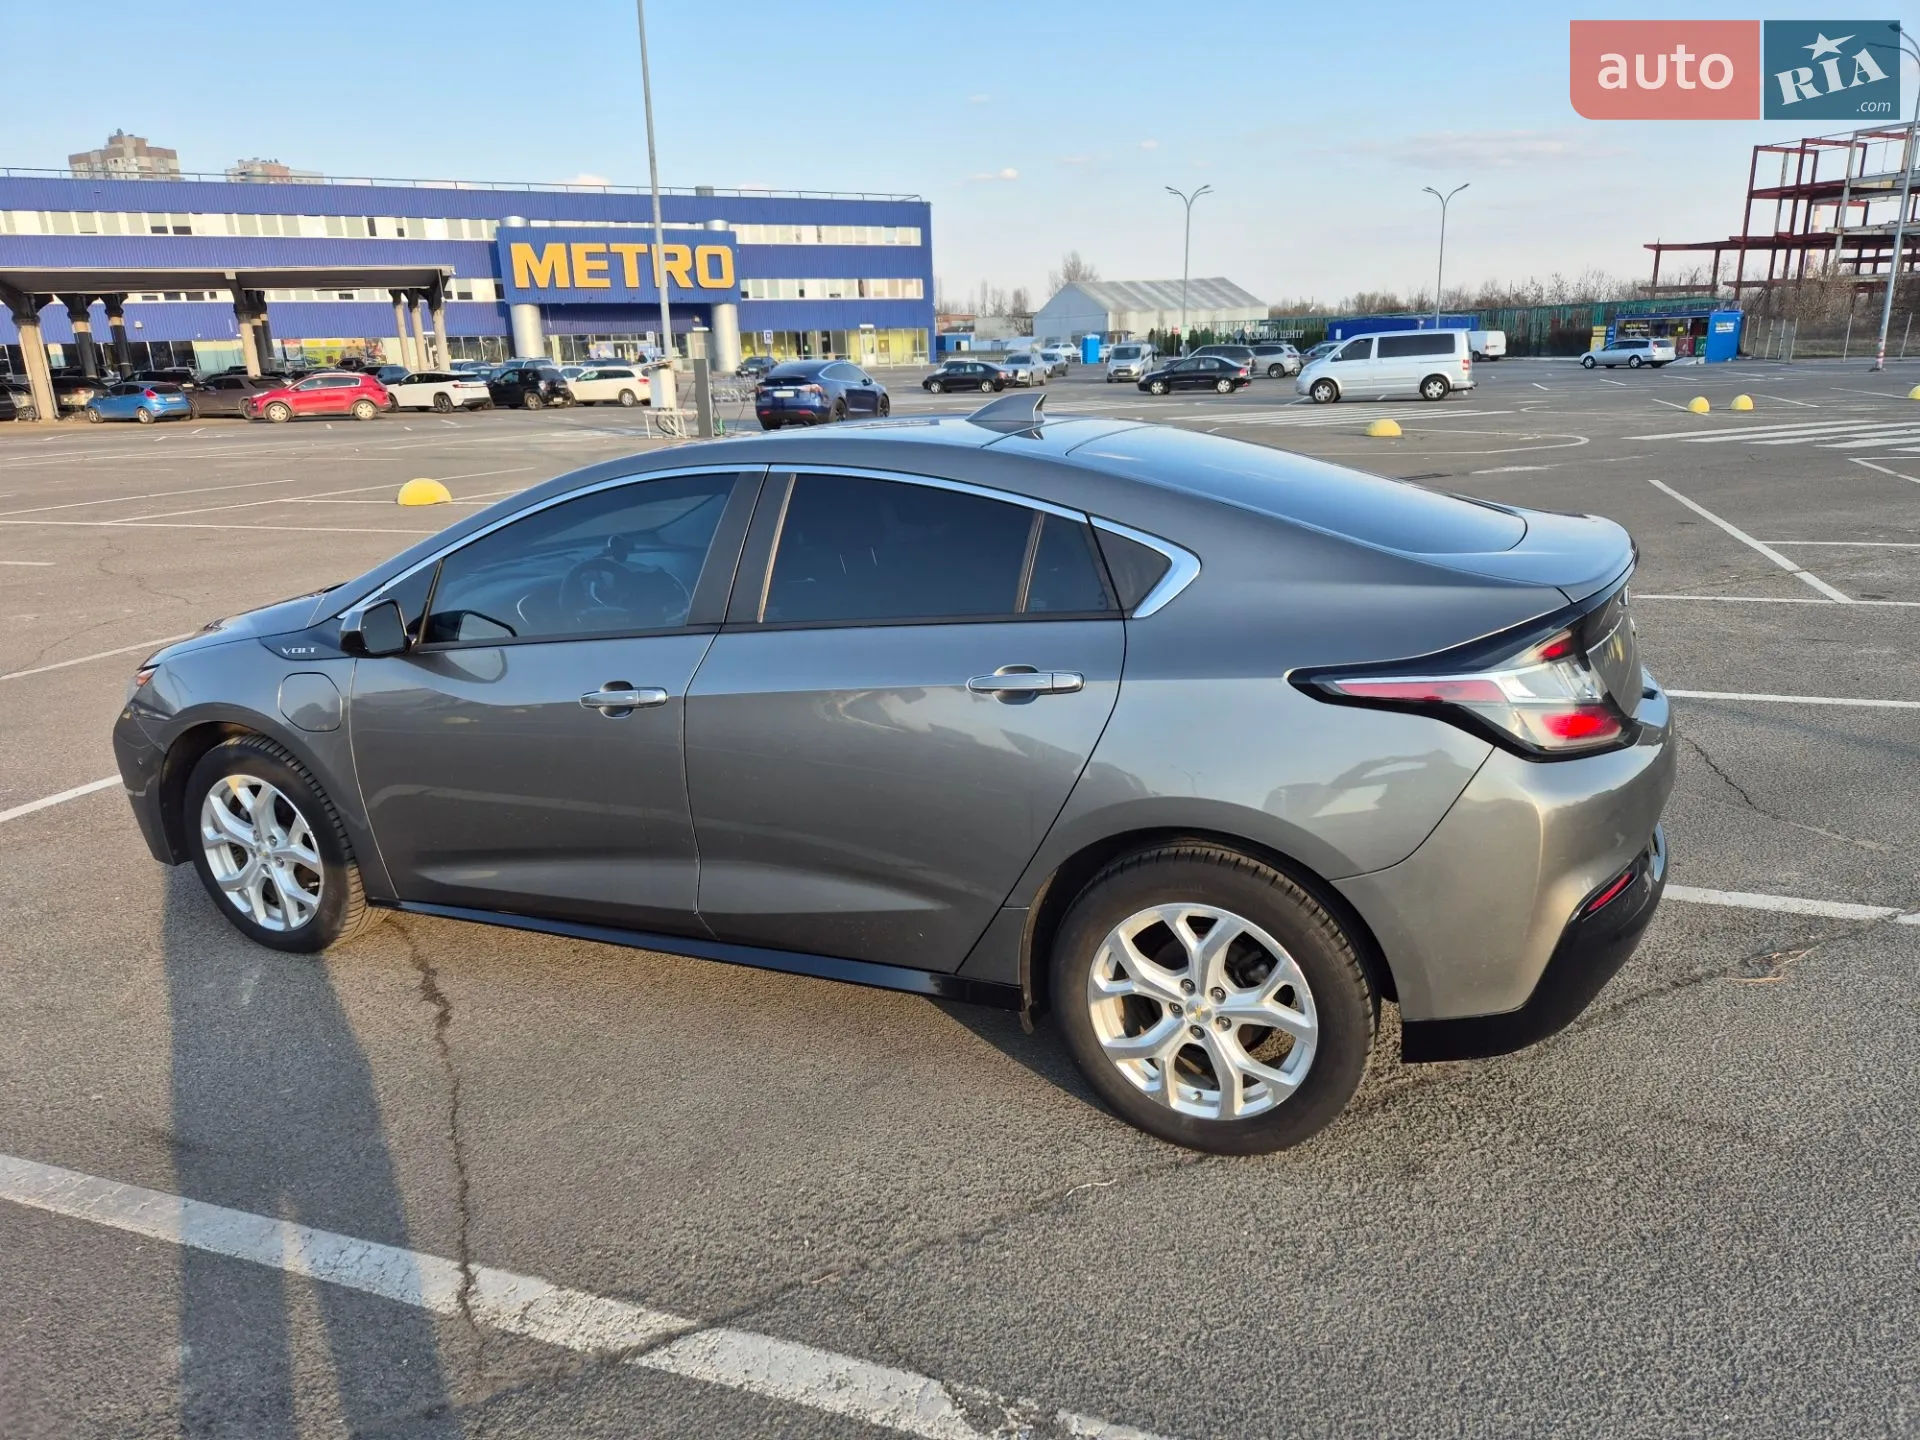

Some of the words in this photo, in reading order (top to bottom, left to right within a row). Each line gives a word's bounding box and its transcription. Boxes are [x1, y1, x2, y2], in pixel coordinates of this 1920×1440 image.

[510, 242, 735, 289] METRO
[1280, 329, 1304, 339] ЦЕНТР
[281, 647, 317, 655] VOLT
